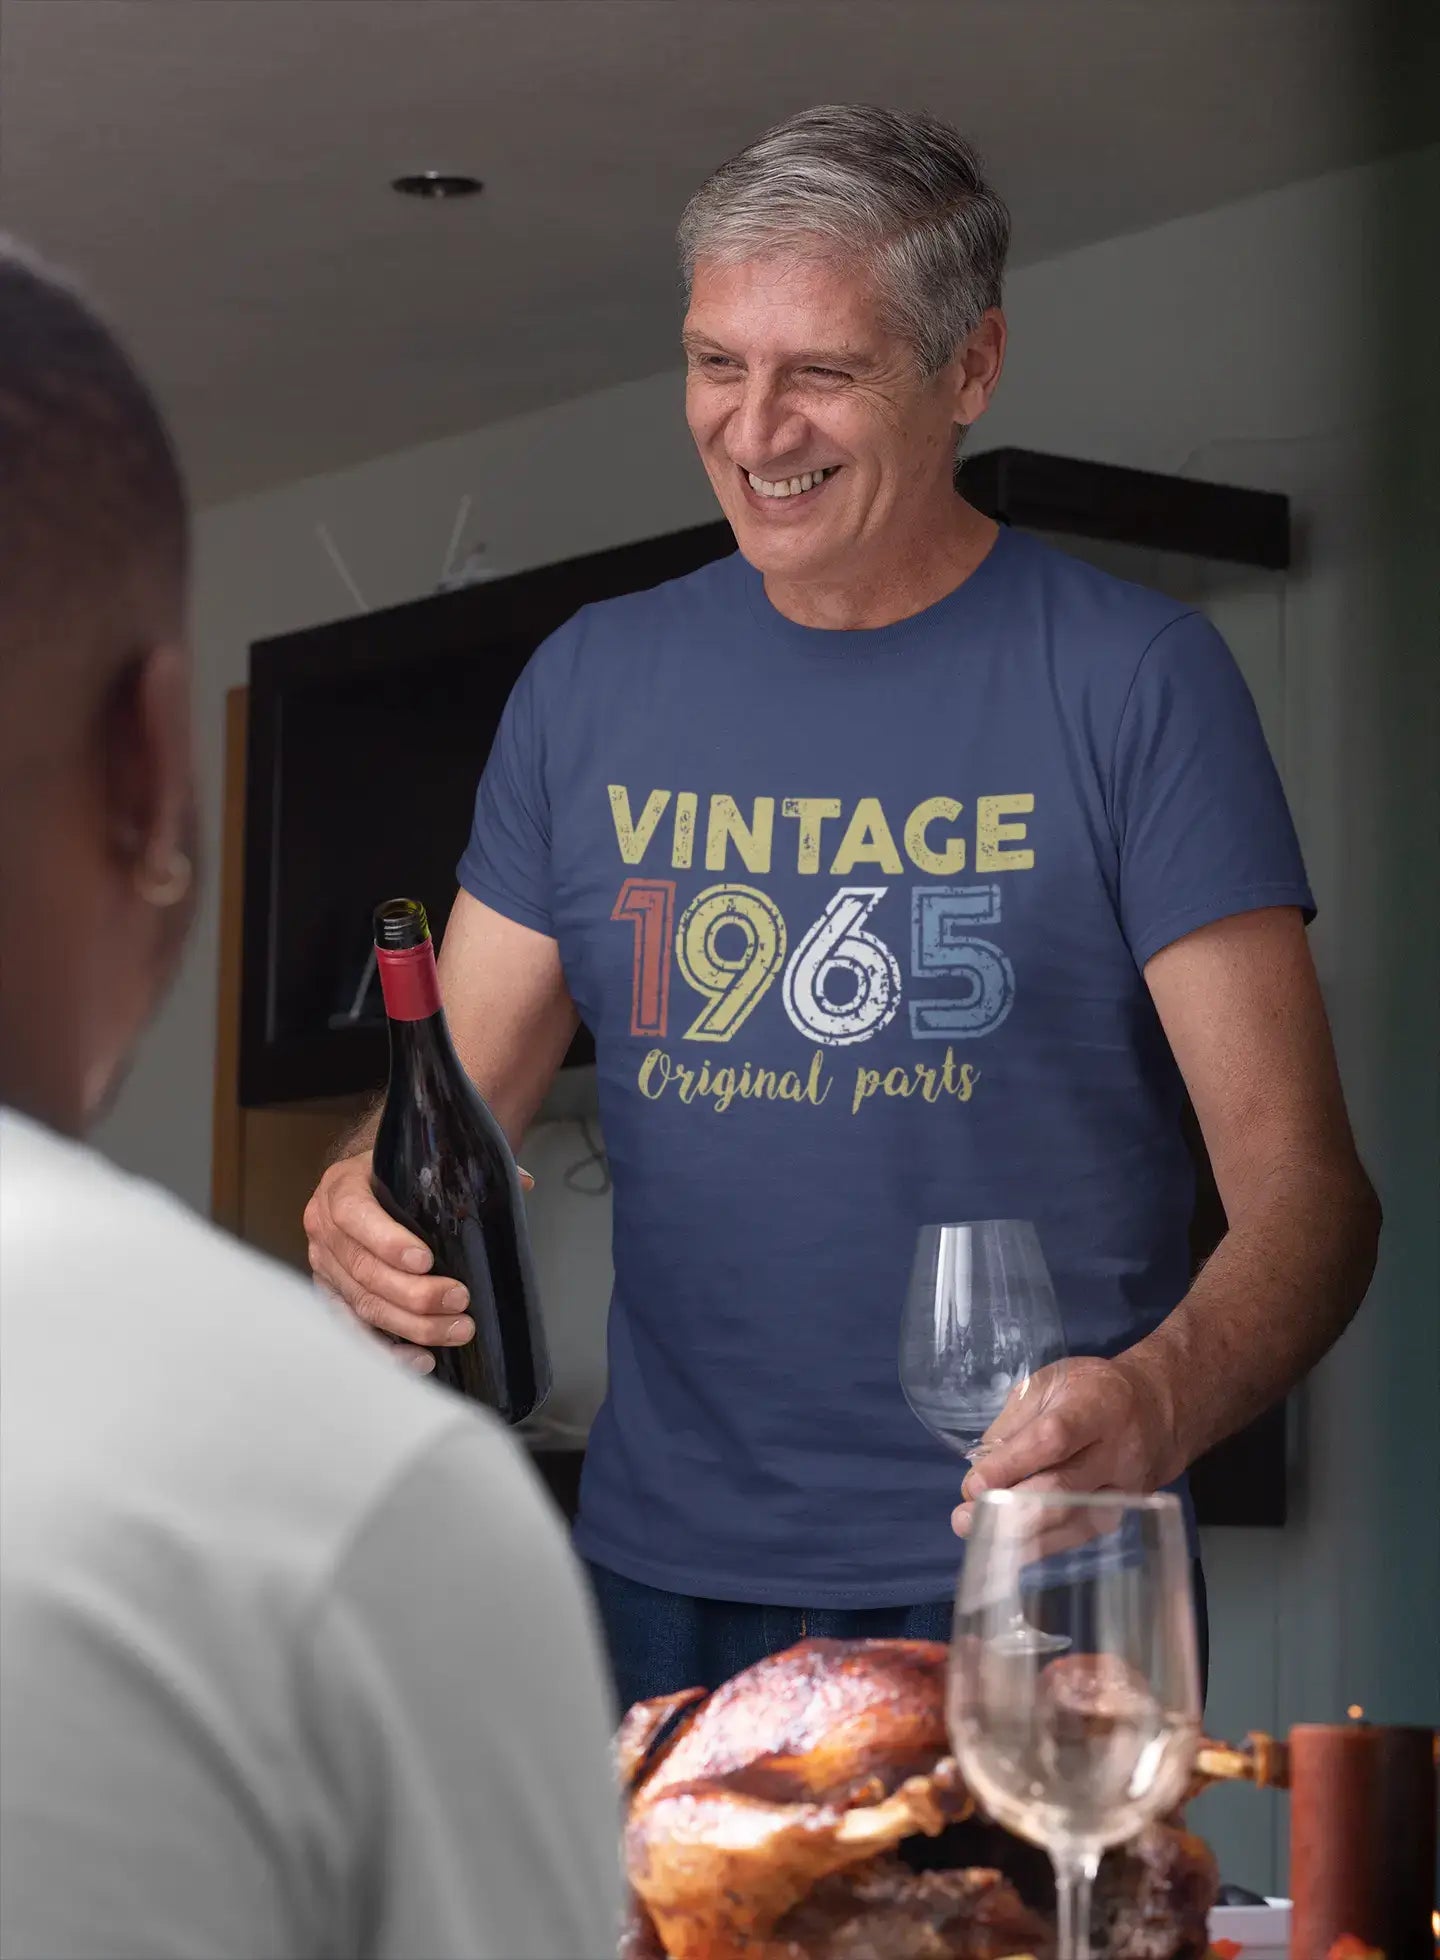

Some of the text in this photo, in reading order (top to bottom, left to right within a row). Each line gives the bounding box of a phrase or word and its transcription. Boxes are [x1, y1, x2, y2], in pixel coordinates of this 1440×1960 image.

[607, 784, 1035, 875] VINTAGE
[610, 878, 1016, 1047] 1965
[638, 1046, 981, 1115] Original parts
